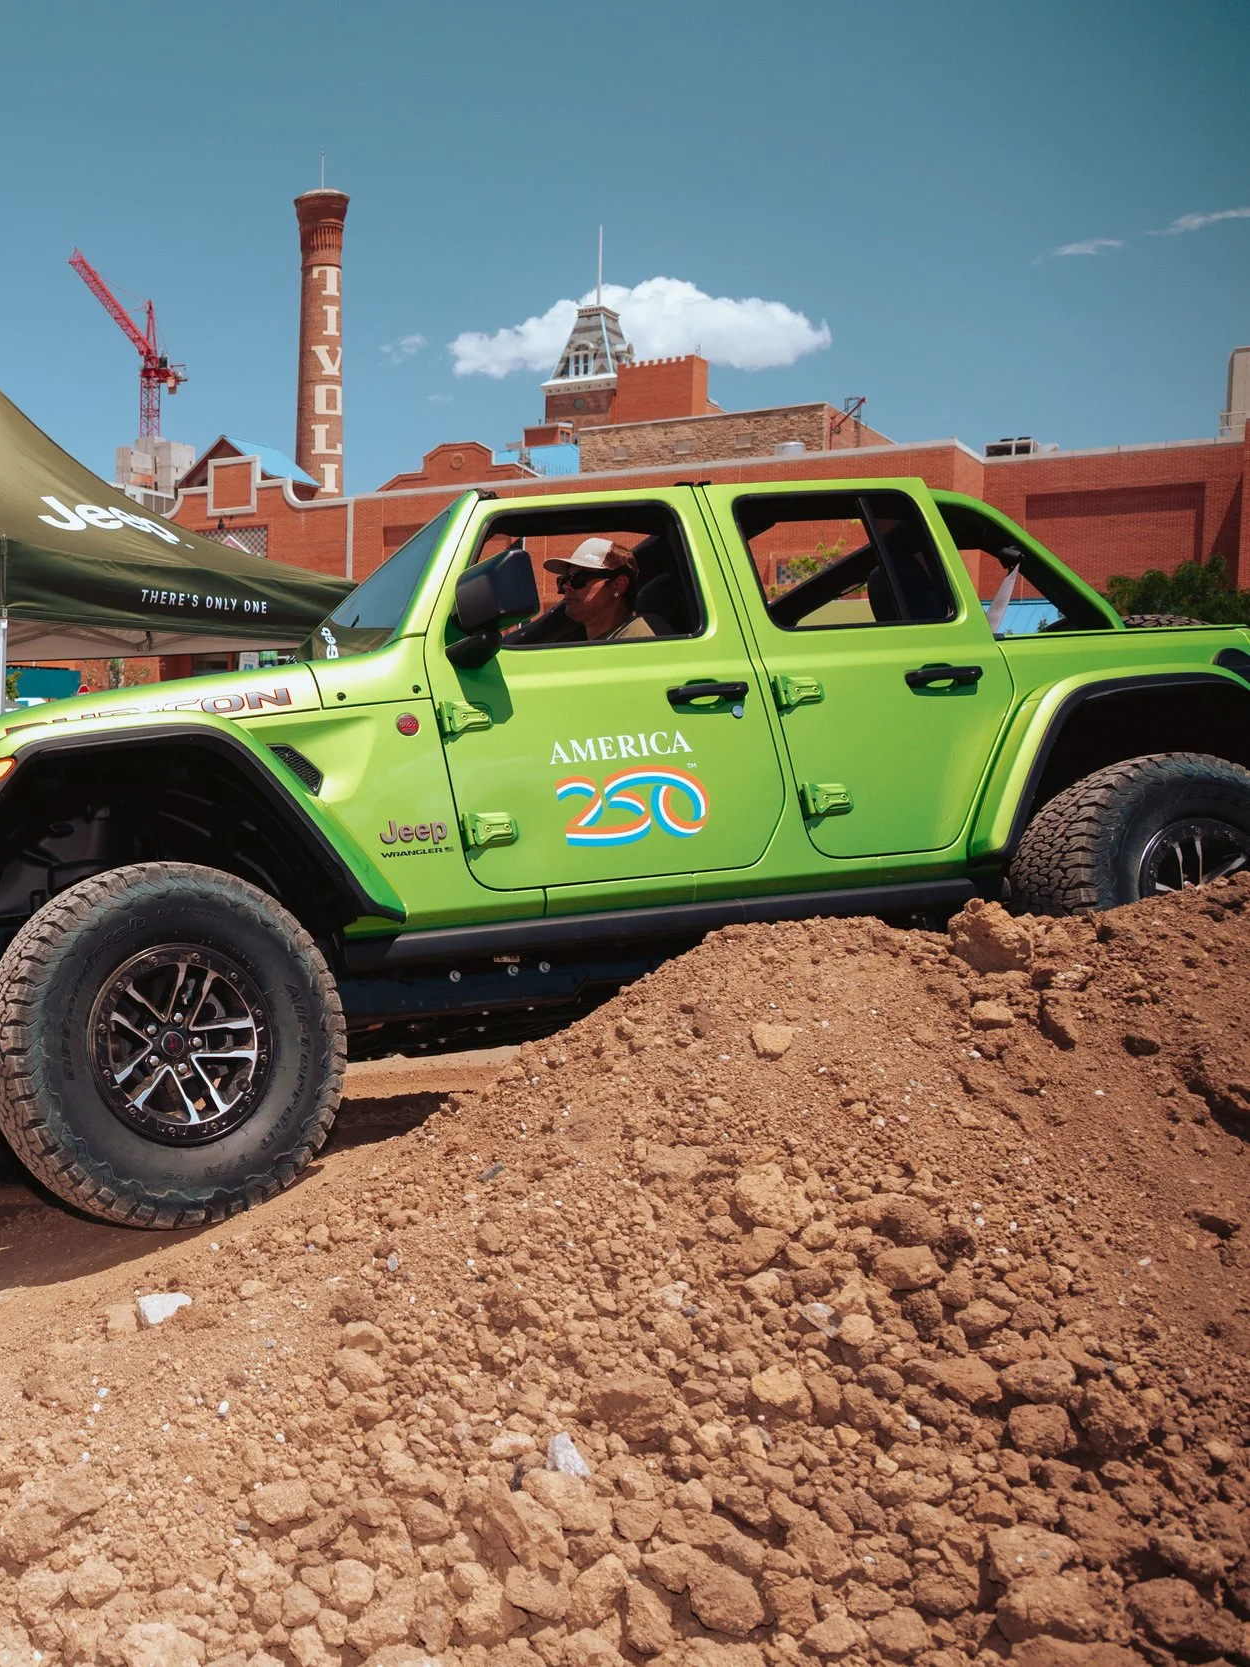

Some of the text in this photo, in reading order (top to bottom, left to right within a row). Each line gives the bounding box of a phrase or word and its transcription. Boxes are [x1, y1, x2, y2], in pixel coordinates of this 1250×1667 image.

[311, 266, 342, 493] TIVOLI
[38, 496, 181, 544] Jeep
[141, 589, 267, 614] THERE'S ONLY ONE
[550, 730, 693, 765] AMERICA
[556, 764, 710, 847] 250
[379, 819, 447, 845] Jeep
[381, 848, 443, 858] WRANGLER
